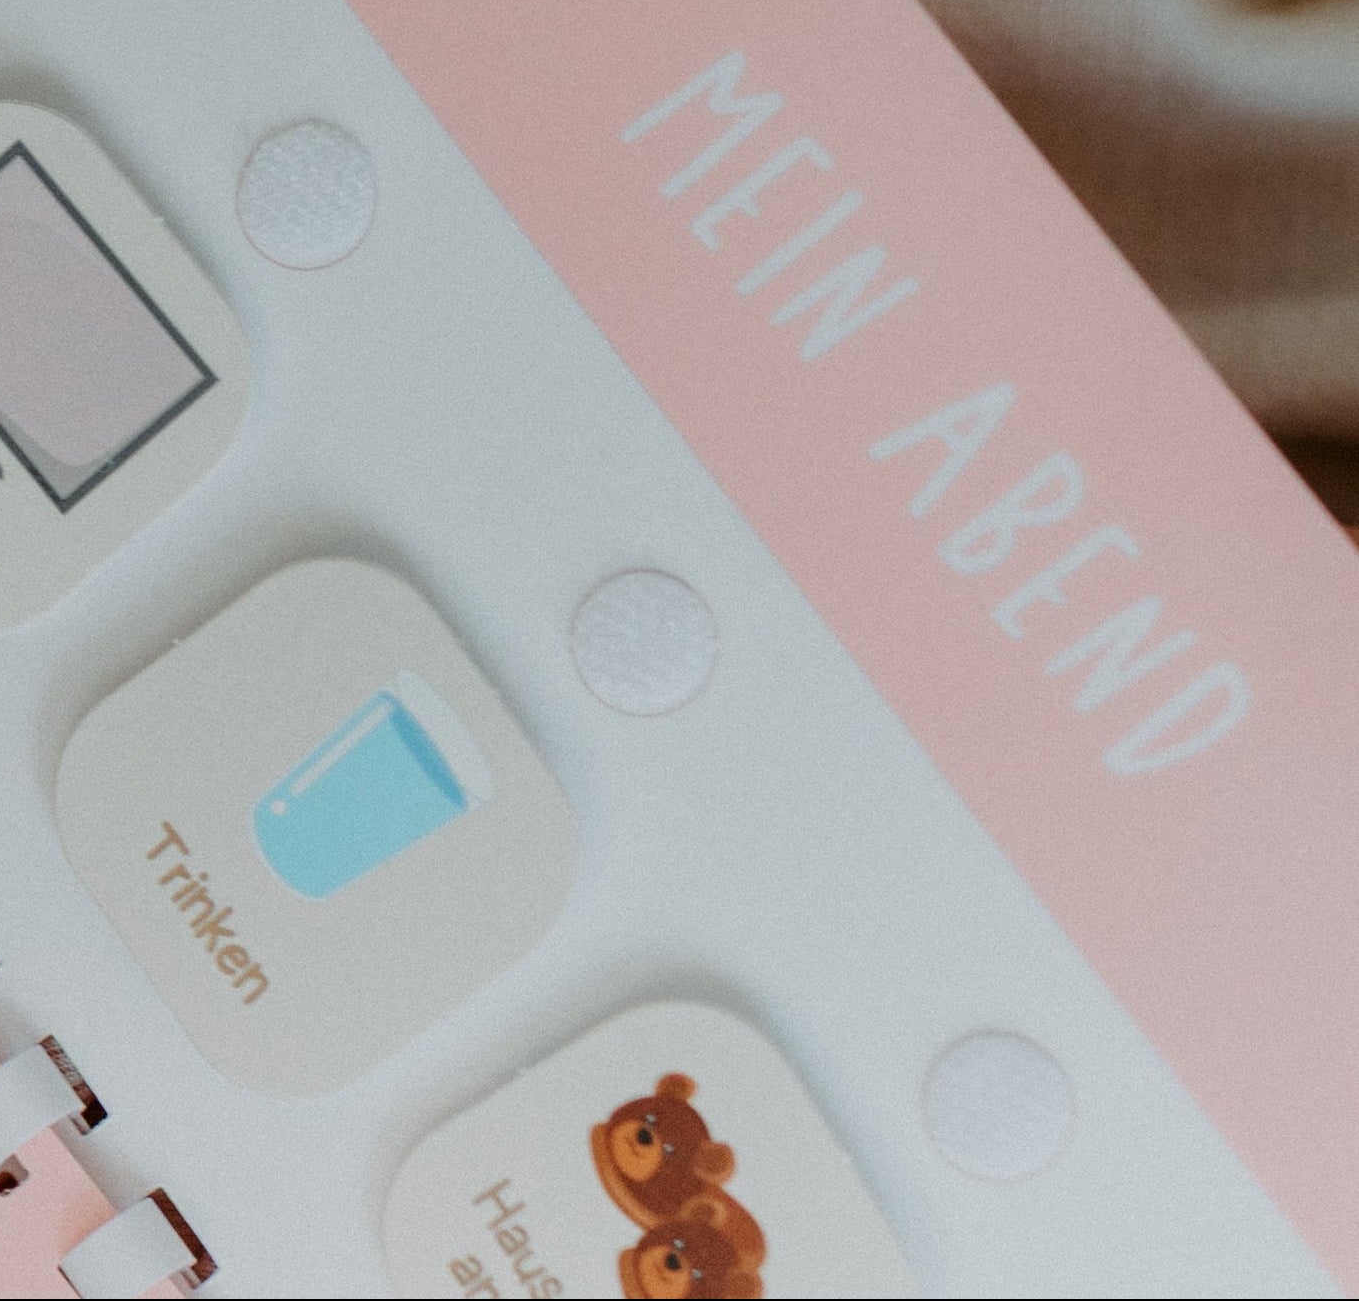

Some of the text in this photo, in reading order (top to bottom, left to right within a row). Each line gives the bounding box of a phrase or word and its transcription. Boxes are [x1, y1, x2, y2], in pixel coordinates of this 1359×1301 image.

[619, 49, 1251, 776] MEIN ABEND
[146, 821, 272, 1005] Trinken
